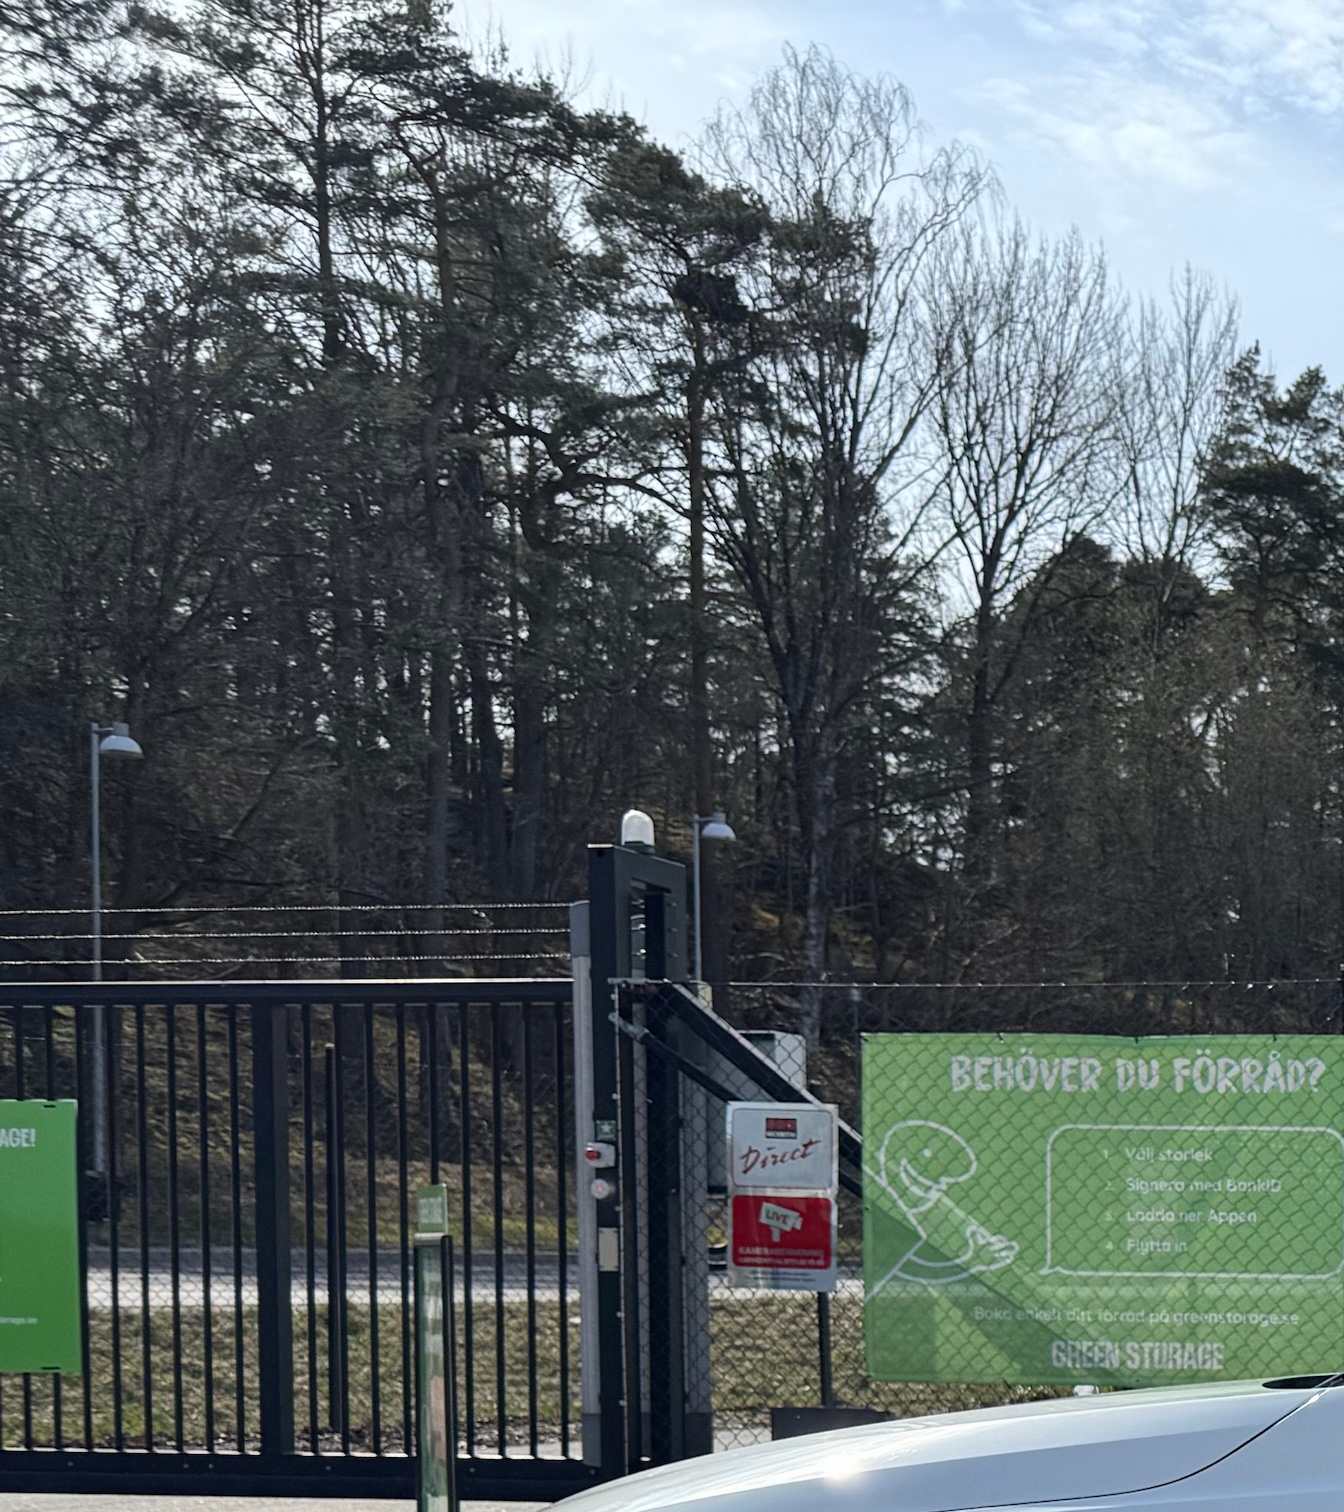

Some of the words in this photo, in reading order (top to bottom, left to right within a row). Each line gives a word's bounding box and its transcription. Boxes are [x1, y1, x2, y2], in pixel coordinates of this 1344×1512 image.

[951, 1047, 1103, 1093] BEHÖVER
[1116, 1058, 1160, 1093] DU
[1172, 1049, 1327, 1094] FÖRRÅD?
[740, 1138, 822, 1175] Direct
[1158, 1148, 1213, 1162] storlek
[1126, 1178, 1185, 1195] Signera
[1190, 1178, 1222, 1192] med
[1226, 1178, 1282, 1193] BankID
[765, 1209, 791, 1225] LIVE
[1127, 1210, 1175, 1222] Ladda
[1180, 1212, 1201, 1222] ner
[1208, 1210, 1257, 1225] Appen
[1051, 1340, 1119, 1369] GREEN
[1126, 1340, 1224, 1370] STORAGE
